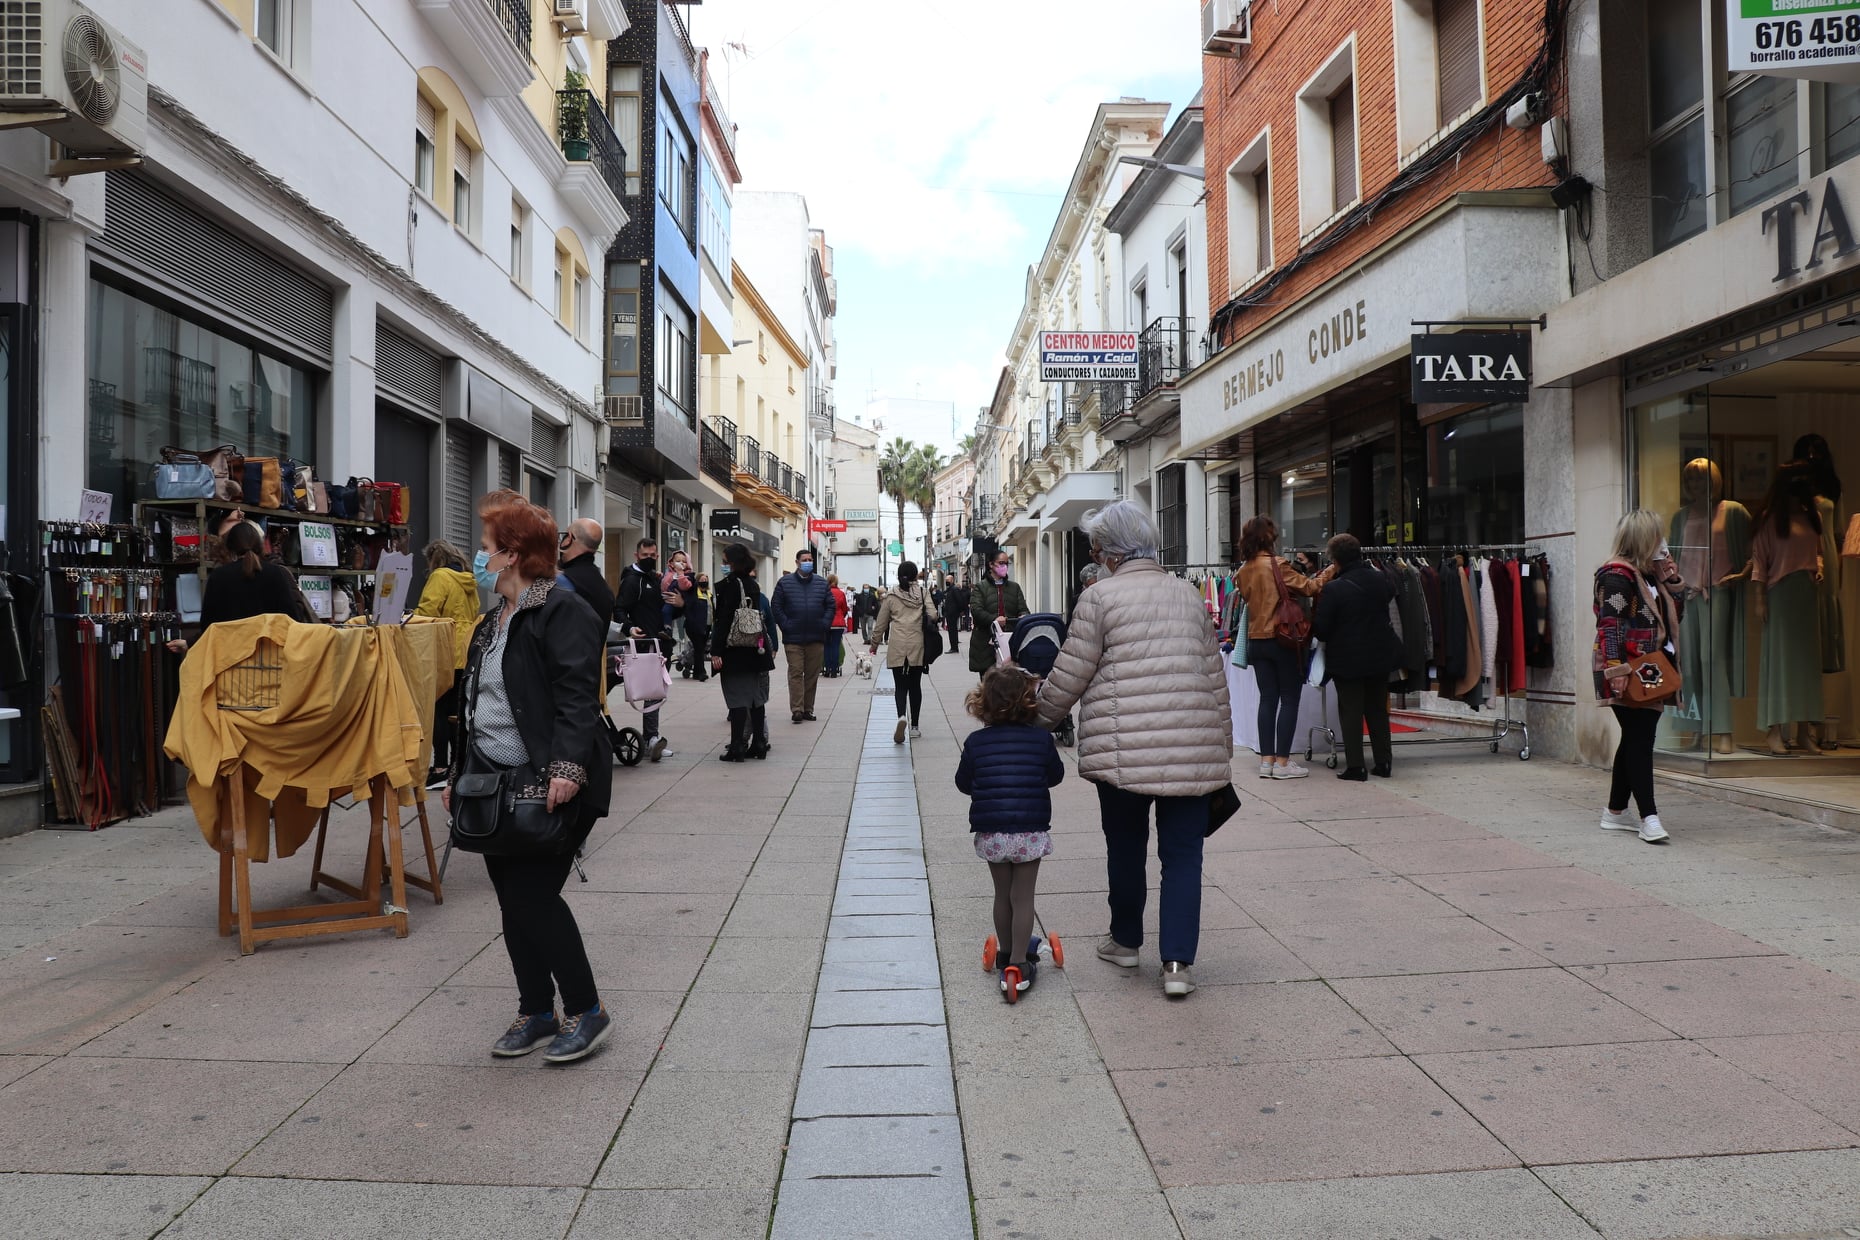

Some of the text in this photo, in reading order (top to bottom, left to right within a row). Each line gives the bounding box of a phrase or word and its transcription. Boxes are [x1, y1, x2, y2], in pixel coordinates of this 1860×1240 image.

[1756, 14, 1860, 49] 676 458
[1750, 49, 1796, 63] borrallo
[1045, 334, 1135, 350] CENTRO MEDICO
[1046, 353, 1136, 364] Ramón y Cajal
[1223, 299, 1367, 411] BERMEJO CONDE
[1045, 367, 1136, 378] CONDUCTORES Y CAZADORES
[1416, 354, 1526, 382] TARA
[846, 511, 875, 519] FARMACIA
[303, 524, 332, 540] BOLSOS
[301, 580, 330, 591] MOCHILAS
